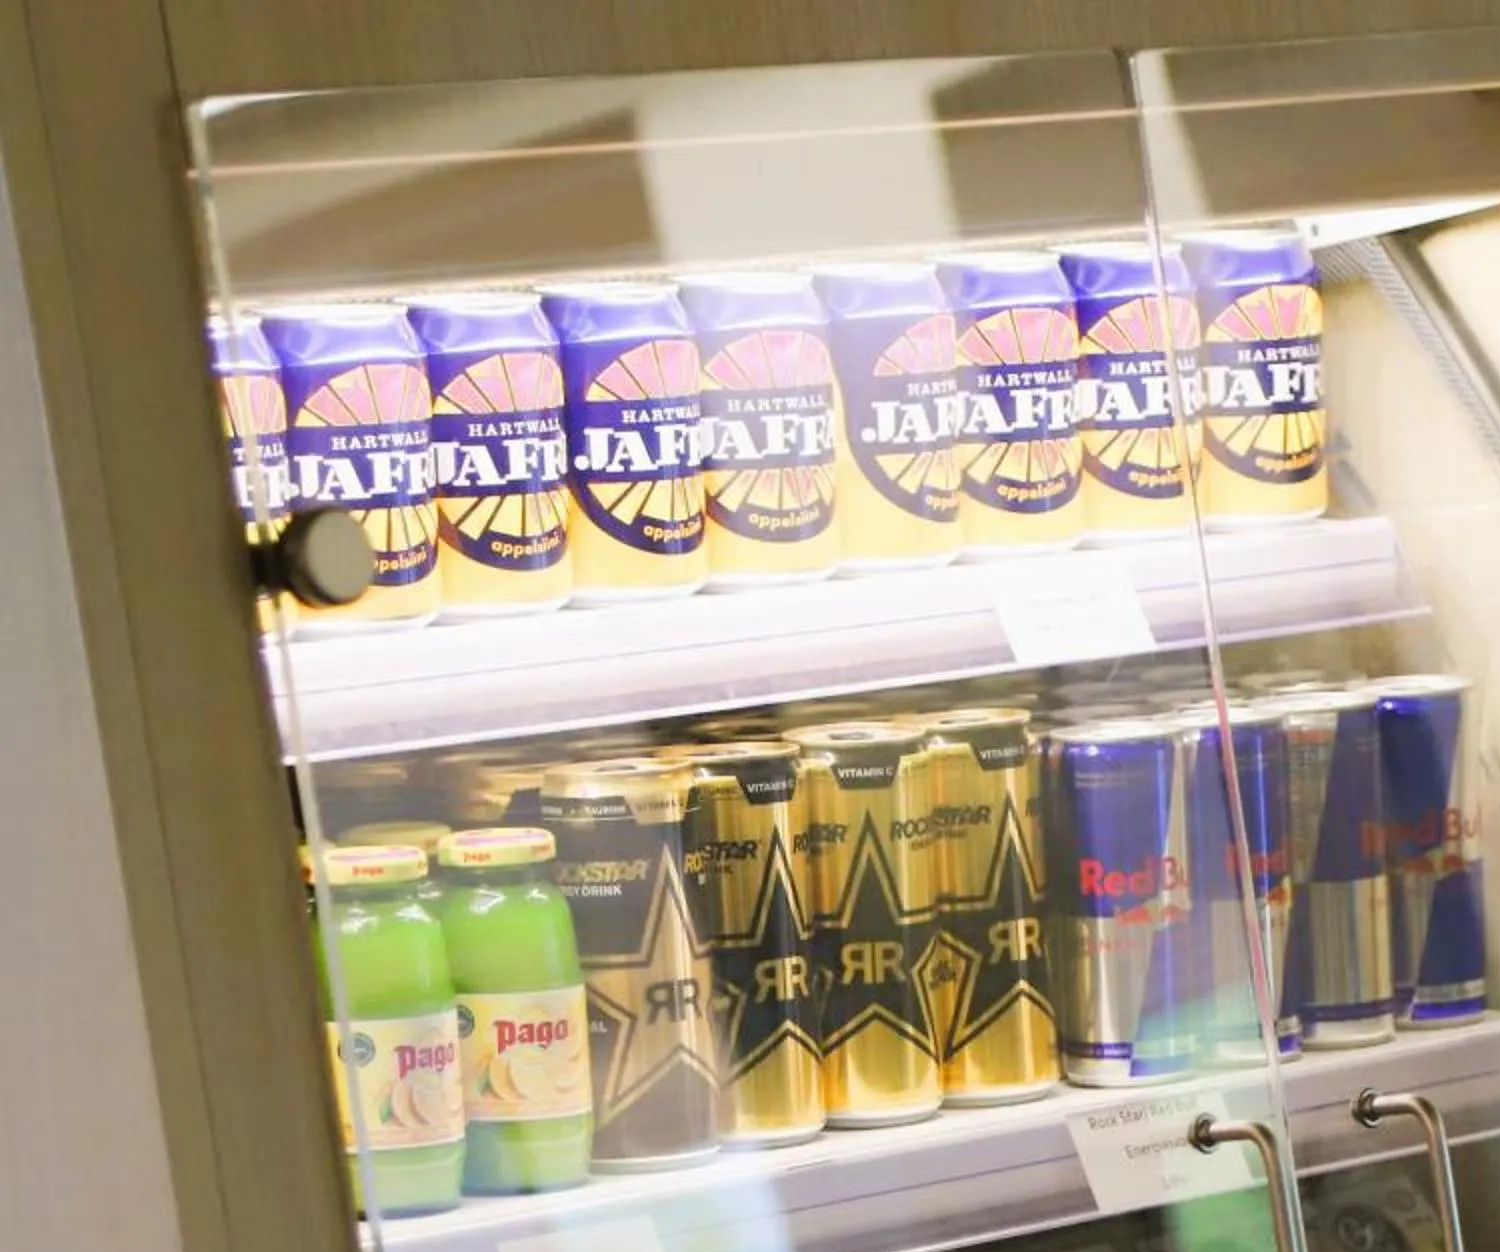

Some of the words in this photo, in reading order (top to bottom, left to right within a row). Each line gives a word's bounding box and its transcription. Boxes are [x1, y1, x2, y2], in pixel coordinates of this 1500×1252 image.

[976, 369, 1074, 388] HARTWALL
[621, 404, 700, 424] HARTWAL
[468, 417, 562, 437] HARTWALL
[837, 766, 885, 779] VITAMIN
[1079, 852, 1157, 897] Red
